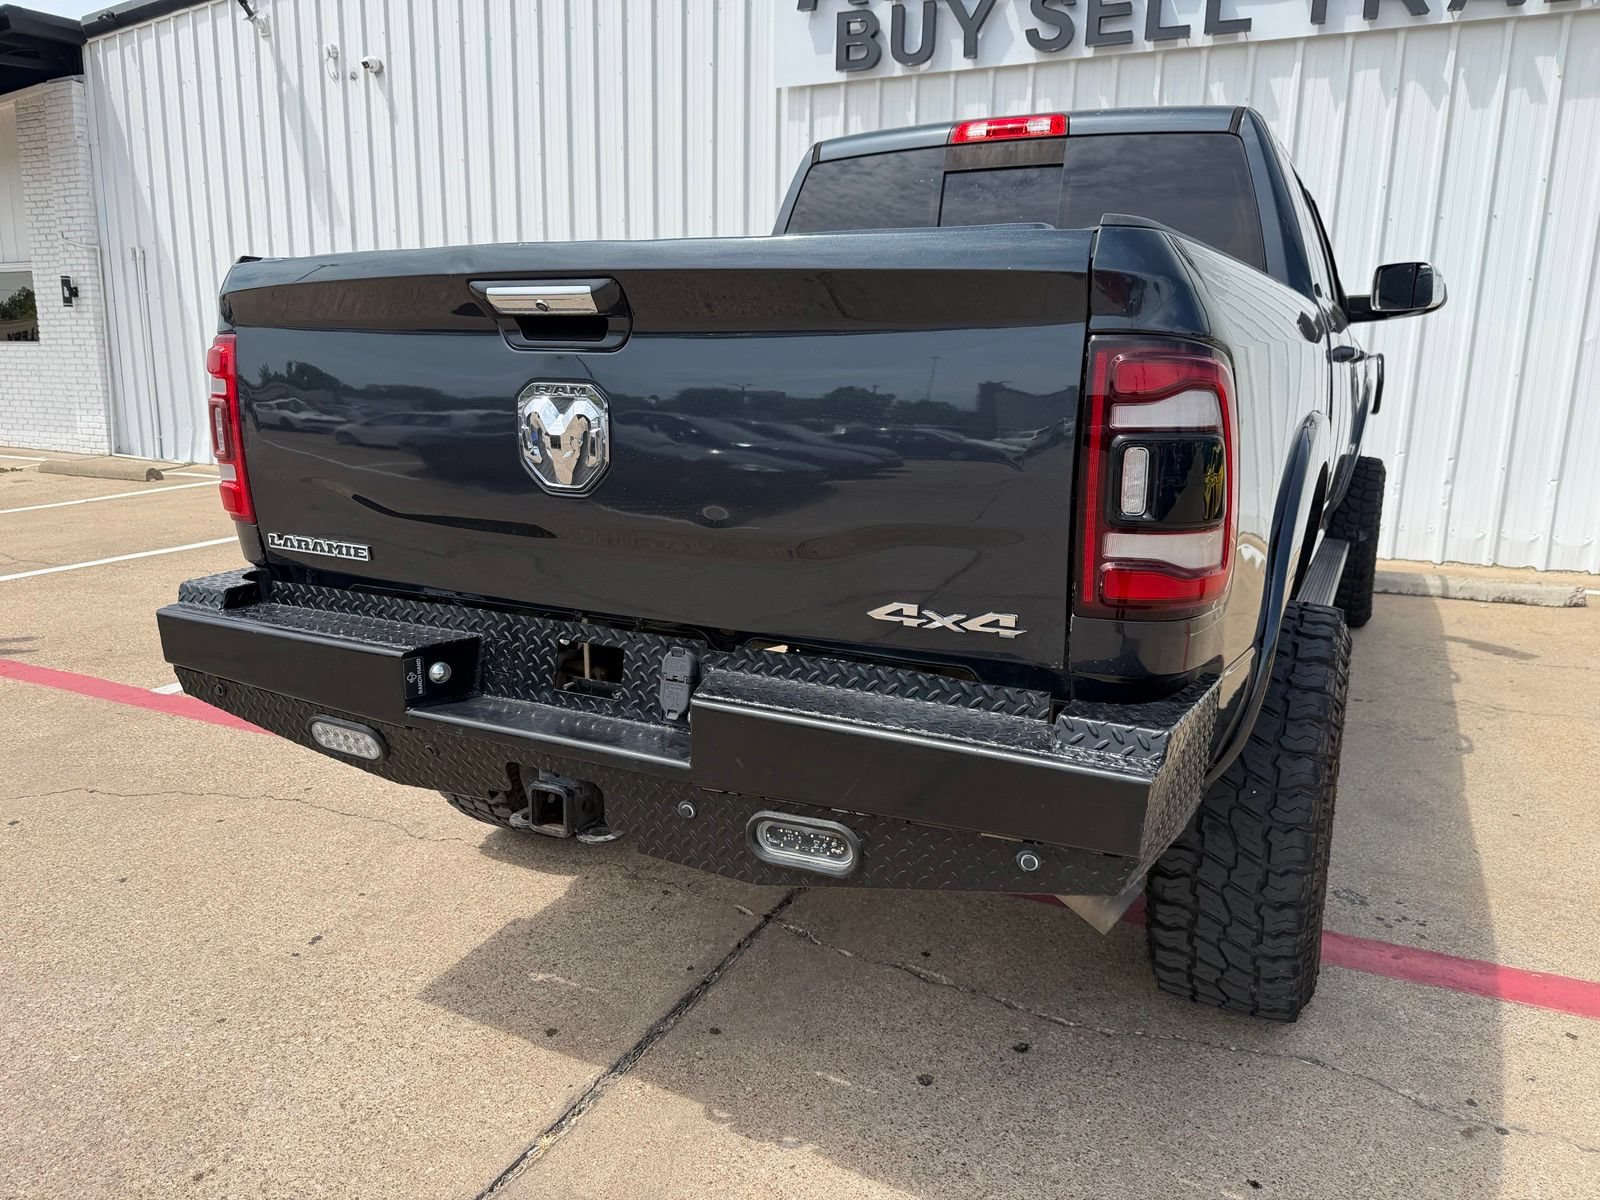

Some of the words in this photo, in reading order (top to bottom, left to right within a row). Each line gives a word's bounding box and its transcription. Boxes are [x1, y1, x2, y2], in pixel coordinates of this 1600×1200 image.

[836, 0, 995, 72] BUY
[533, 385, 587, 397] RAM
[267, 532, 371, 562] LARAMIE
